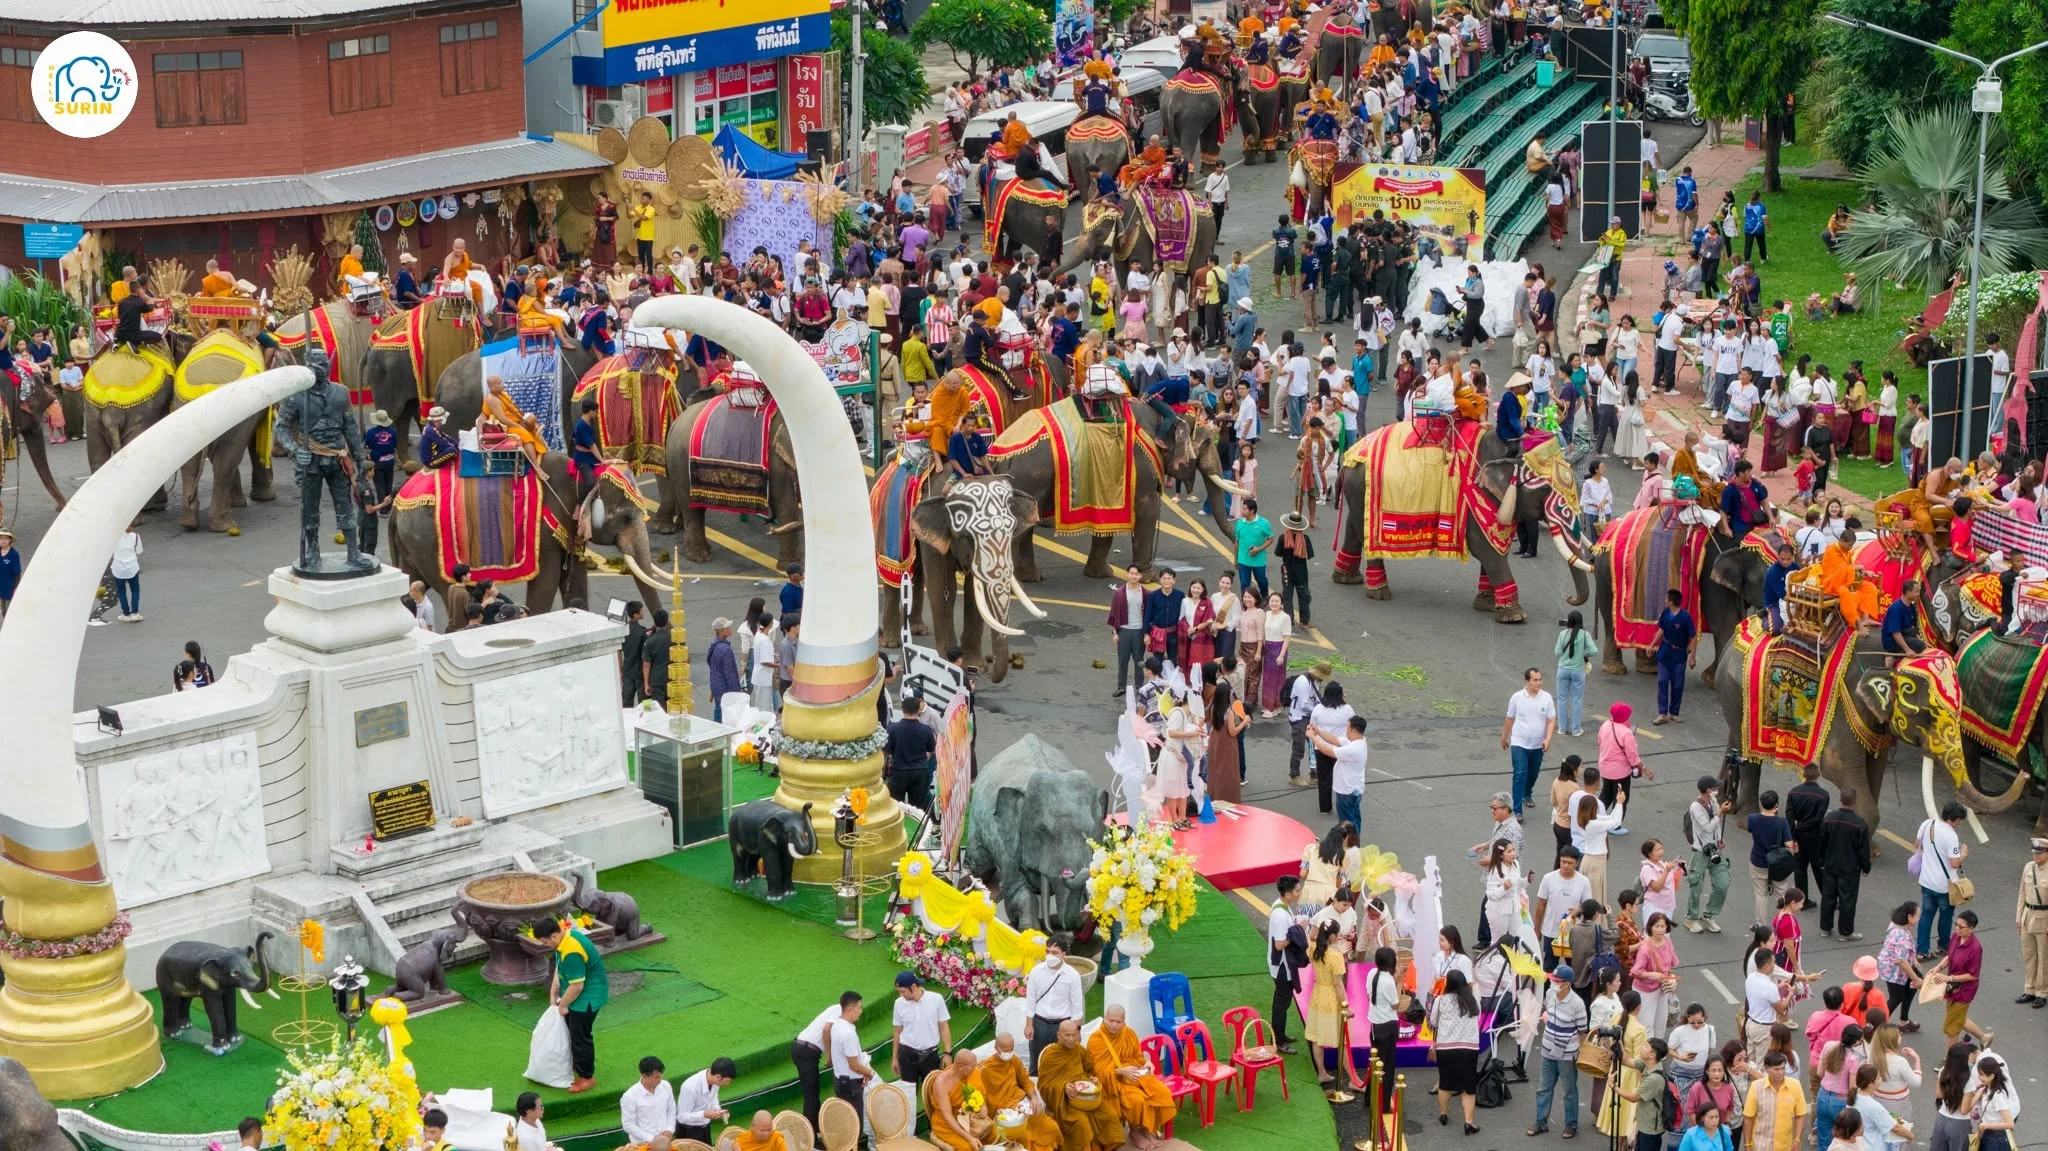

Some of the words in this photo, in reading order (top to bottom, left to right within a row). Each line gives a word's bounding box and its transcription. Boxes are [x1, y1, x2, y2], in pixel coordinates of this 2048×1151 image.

[755, 18, 800, 51] พีทีมันนี่
[634, 38, 697, 76] พีทีสุรินทร์
[793, 57, 817, 81] โรง
[796, 87, 816, 108] รับ
[1387, 191, 1422, 210] ช้าง
